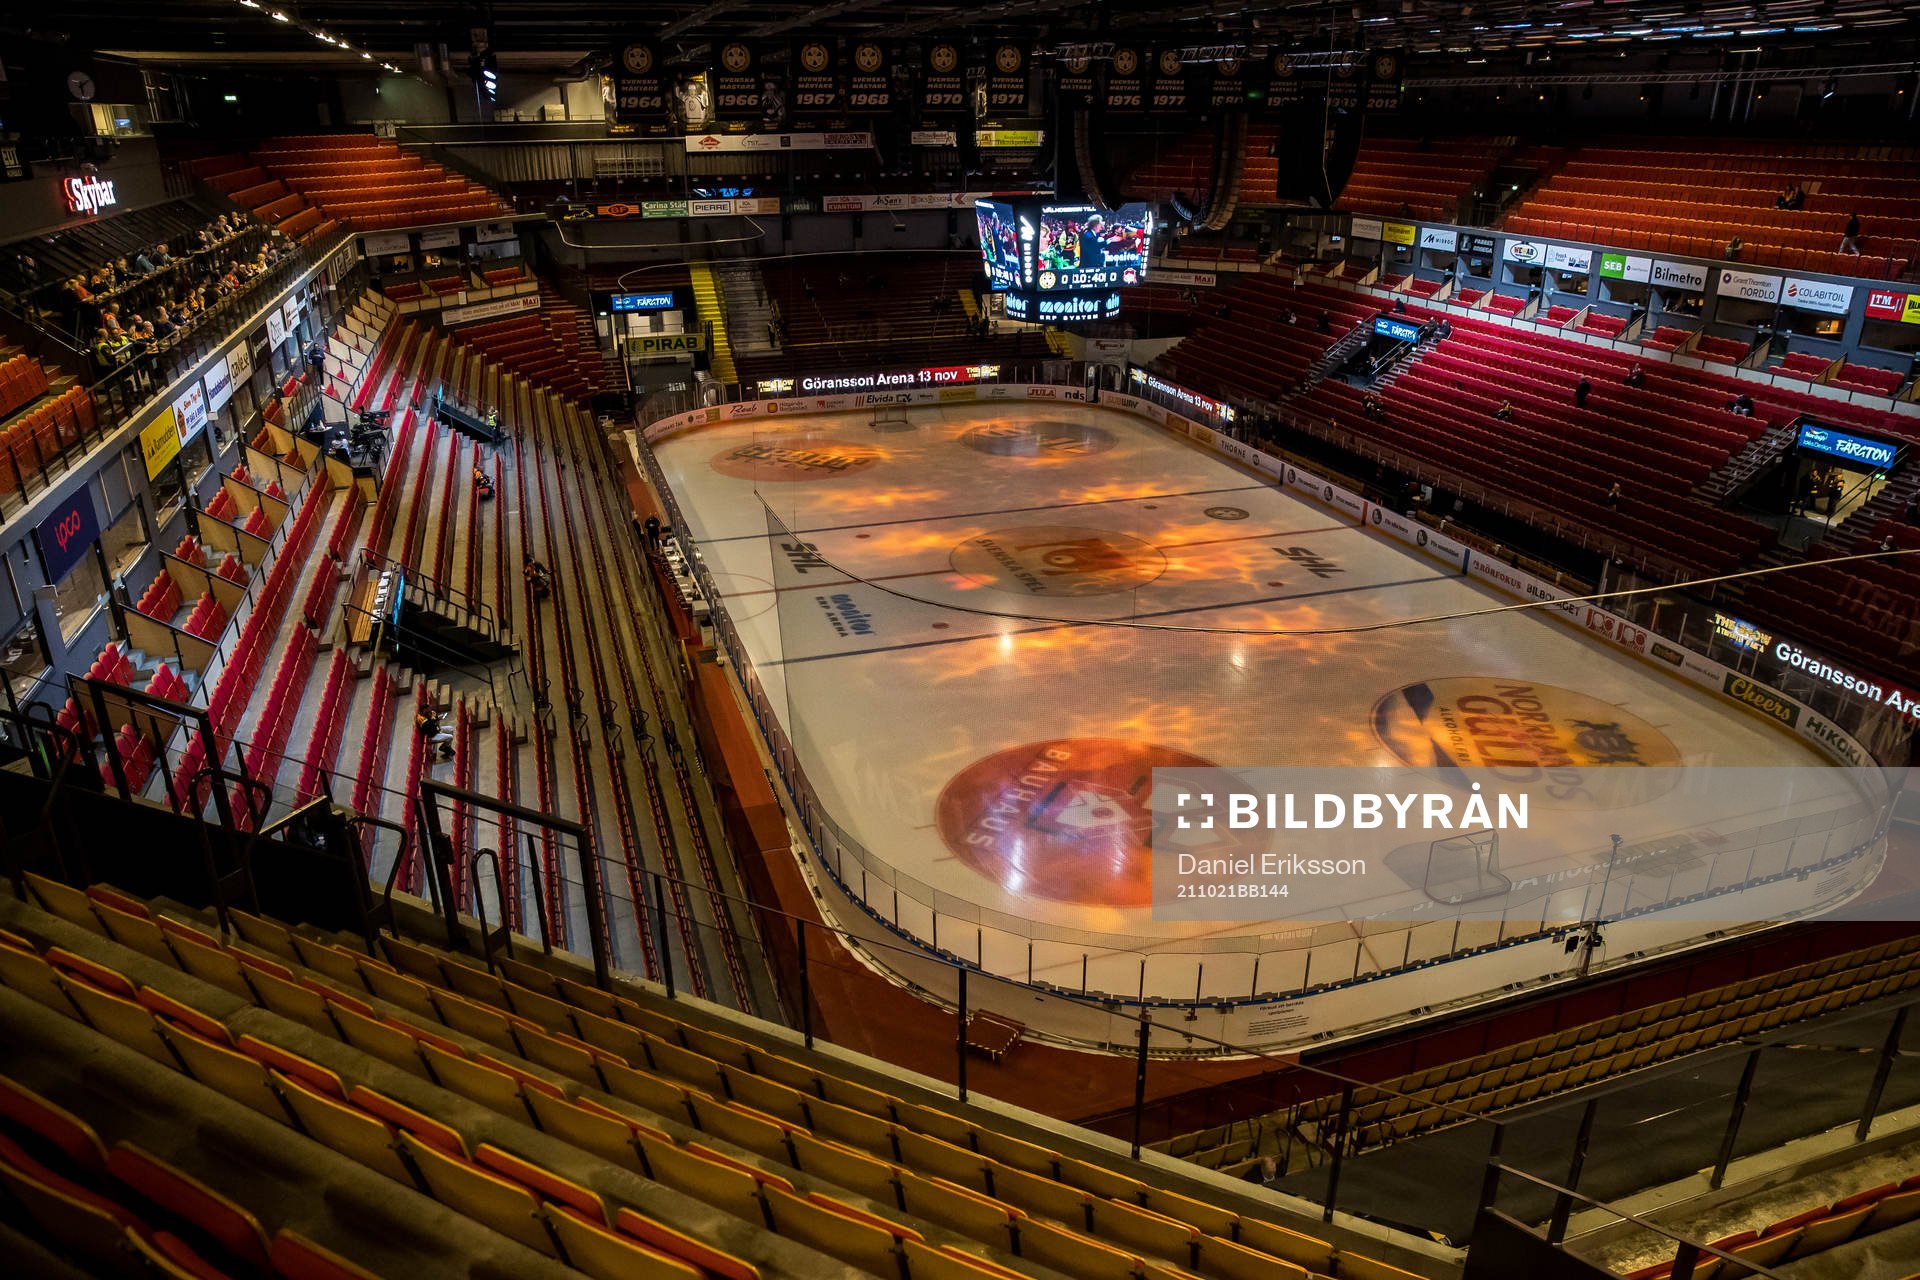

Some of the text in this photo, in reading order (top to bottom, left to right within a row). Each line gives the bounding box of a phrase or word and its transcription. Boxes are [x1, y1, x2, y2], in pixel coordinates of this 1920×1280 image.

[619, 96, 662, 109] 1964
[717, 94, 759, 106] 1966
[796, 93, 836, 105] 1967
[850, 93, 889, 105] 1968
[925, 93, 964, 105] 1970
[991, 94, 1025, 105] 1971
[1107, 95, 1141, 106] 1976
[1153, 95, 1187, 106] 1977
[1367, 97, 1398, 109] 2012
[71, 175, 116, 215] Skybar
[695, 203, 728, 212] PIERRE
[1604, 259, 1623, 271] SEB
[1061, 275, 1069, 284] 0
[1109, 272, 1117, 282] 0
[1194, 275, 1214, 284] MAXI
[1654, 266, 1703, 286] Bilmetro
[1733, 275, 1772, 288] Grant Thornton
[1798, 287, 1845, 303] COLABITOIL
[636, 297, 671, 307] FÄRGTON
[1039, 297, 1102, 313] monitor
[643, 337, 698, 351] PIRAB
[802, 376, 875, 391] Göransson
[876, 373, 915, 386] Arena
[918, 370, 931, 383] 13
[934, 370, 958, 382] nov
[866, 394, 894, 403] Elvida
[1029, 387, 1054, 397] JULA
[1064, 389, 1085, 401] nds
[1148, 376, 1177, 398] Göransson
[1194, 395, 1201, 407] 13
[1201, 400, 1213, 412] nov
[1221, 440, 1247, 460] THORNE
[1835, 438, 1892, 463] FÄRGTON
[975, 538, 1048, 593] SVENSKA SPEL
[1271, 546, 1347, 579] SHL
[1479, 564, 1523, 590] RÖRFOKUS
[825, 612, 849, 638] ARENA
[1775, 642, 1883, 703] Göransson
[1729, 677, 1792, 722] Cheers
[966, 747, 1072, 848] BAUHAUS
